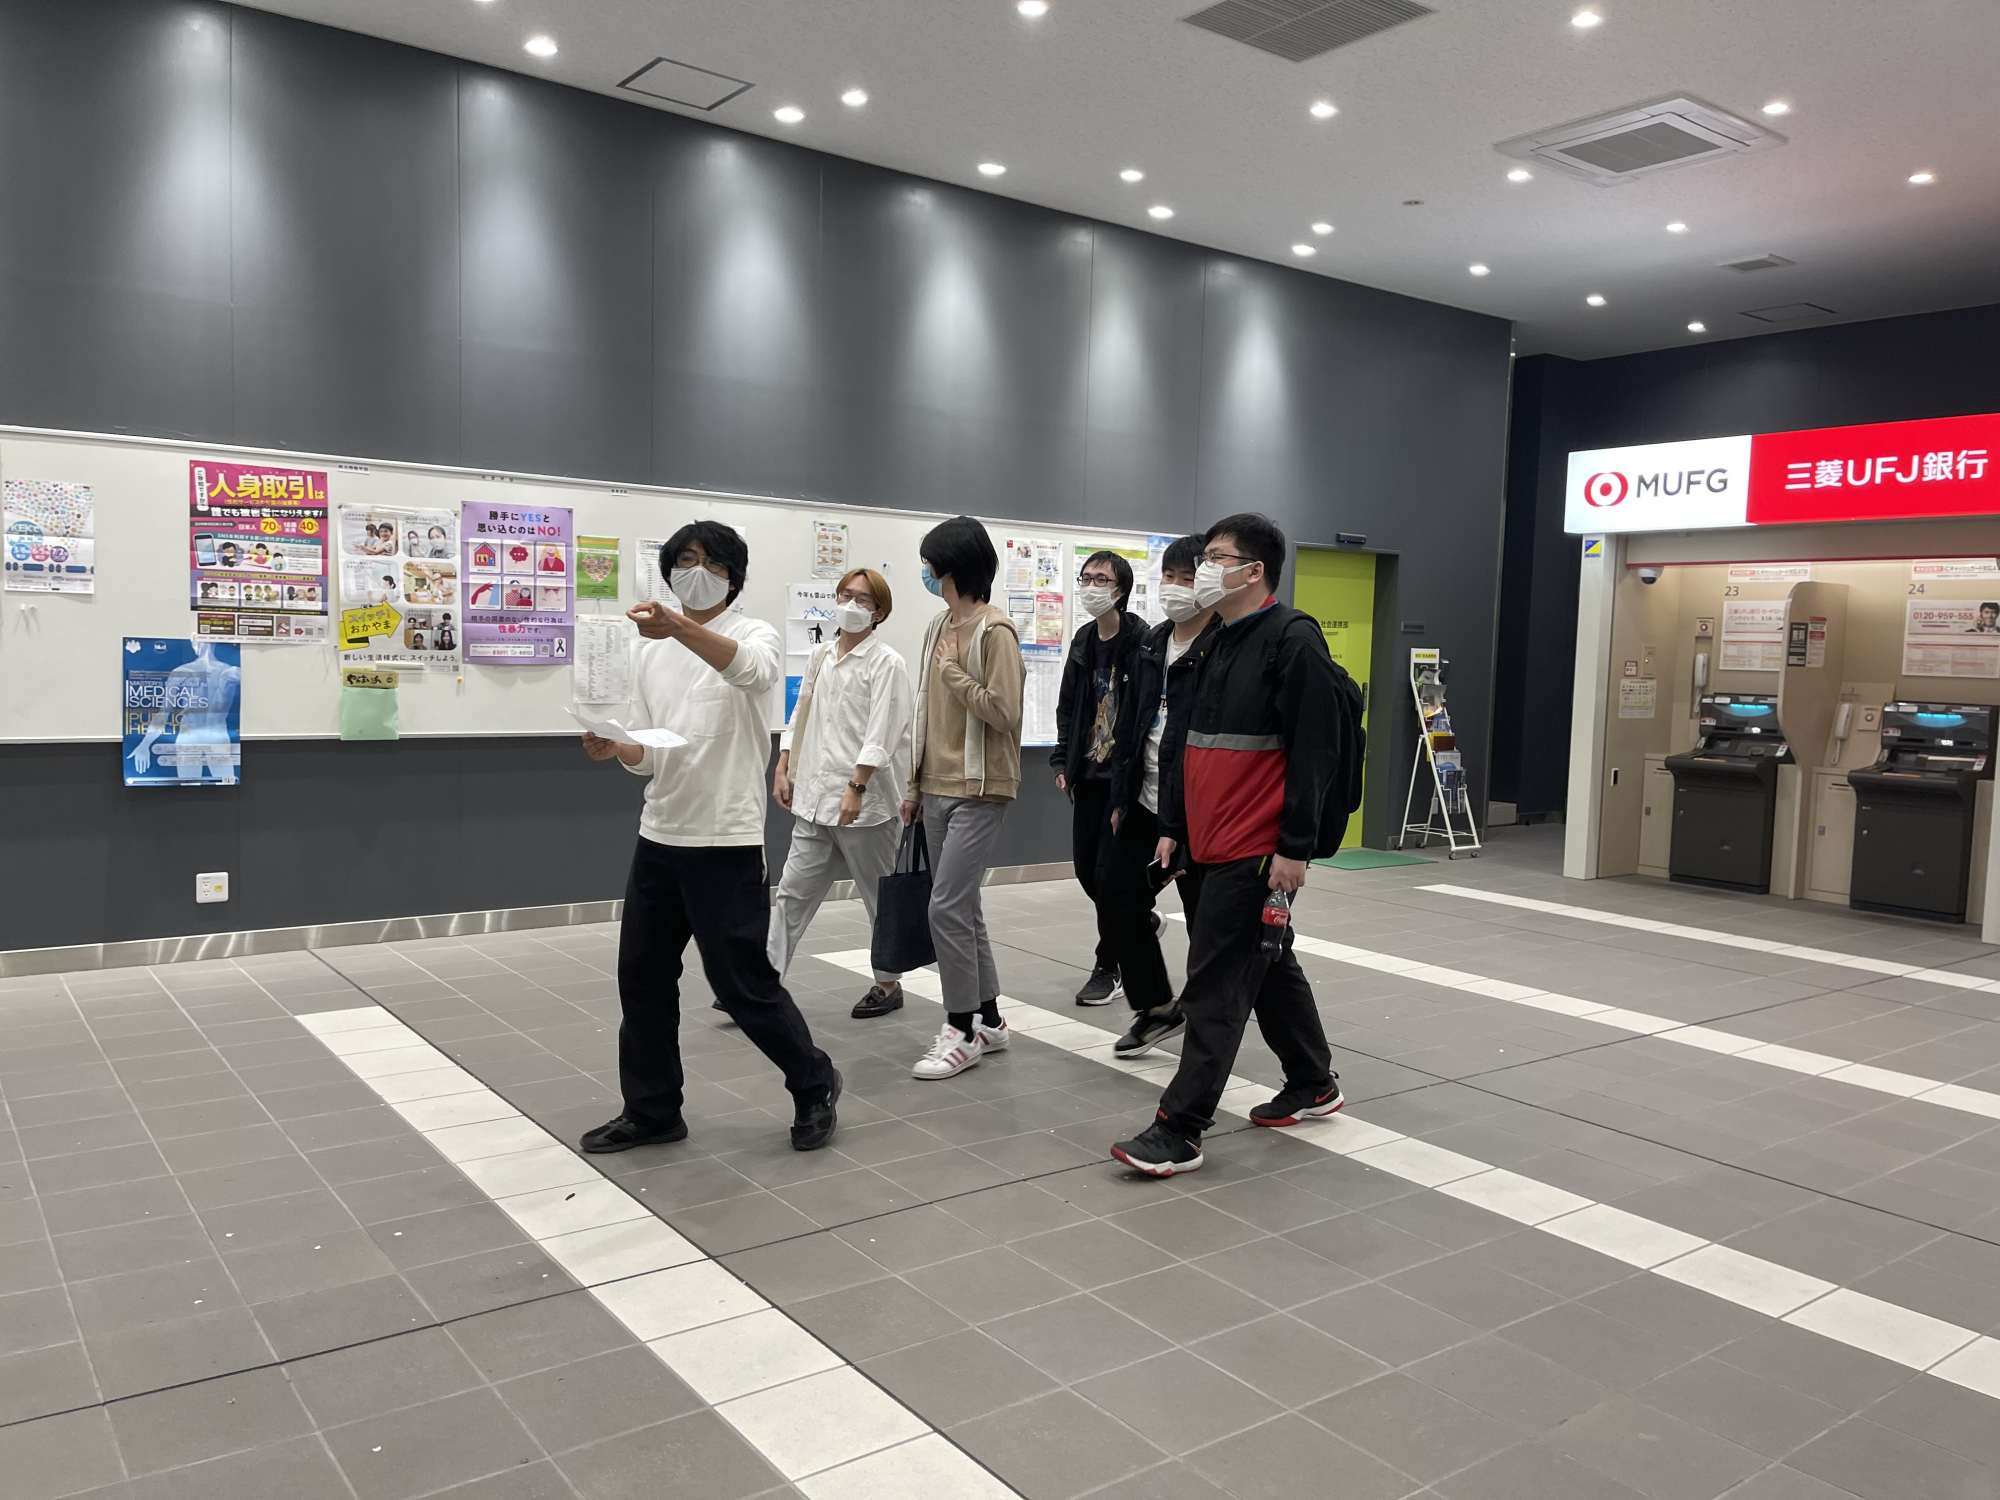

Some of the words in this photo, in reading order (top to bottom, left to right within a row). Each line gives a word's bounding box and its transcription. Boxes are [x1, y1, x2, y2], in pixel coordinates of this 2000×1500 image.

[1784, 449, 1989, 491] 三菱UFJ銀行
[1636, 467, 1729, 498] MUFG
[489, 510, 550, 523] 勝手にYESと
[477, 523, 561, 537] 思い込むのはNO!
[1724, 586, 1739, 597] 23
[1907, 583, 1925, 595] 24
[348, 608, 391, 623] スイッチ!
[1913, 612, 1974, 620] 0120-959-555
[350, 619, 391, 634] おかやま
[129, 685, 200, 698] MEDICAL
[129, 696, 209, 709] SCIENCES
[129, 712, 187, 726] PUBLIC
[129, 723, 192, 736] HEALTH
